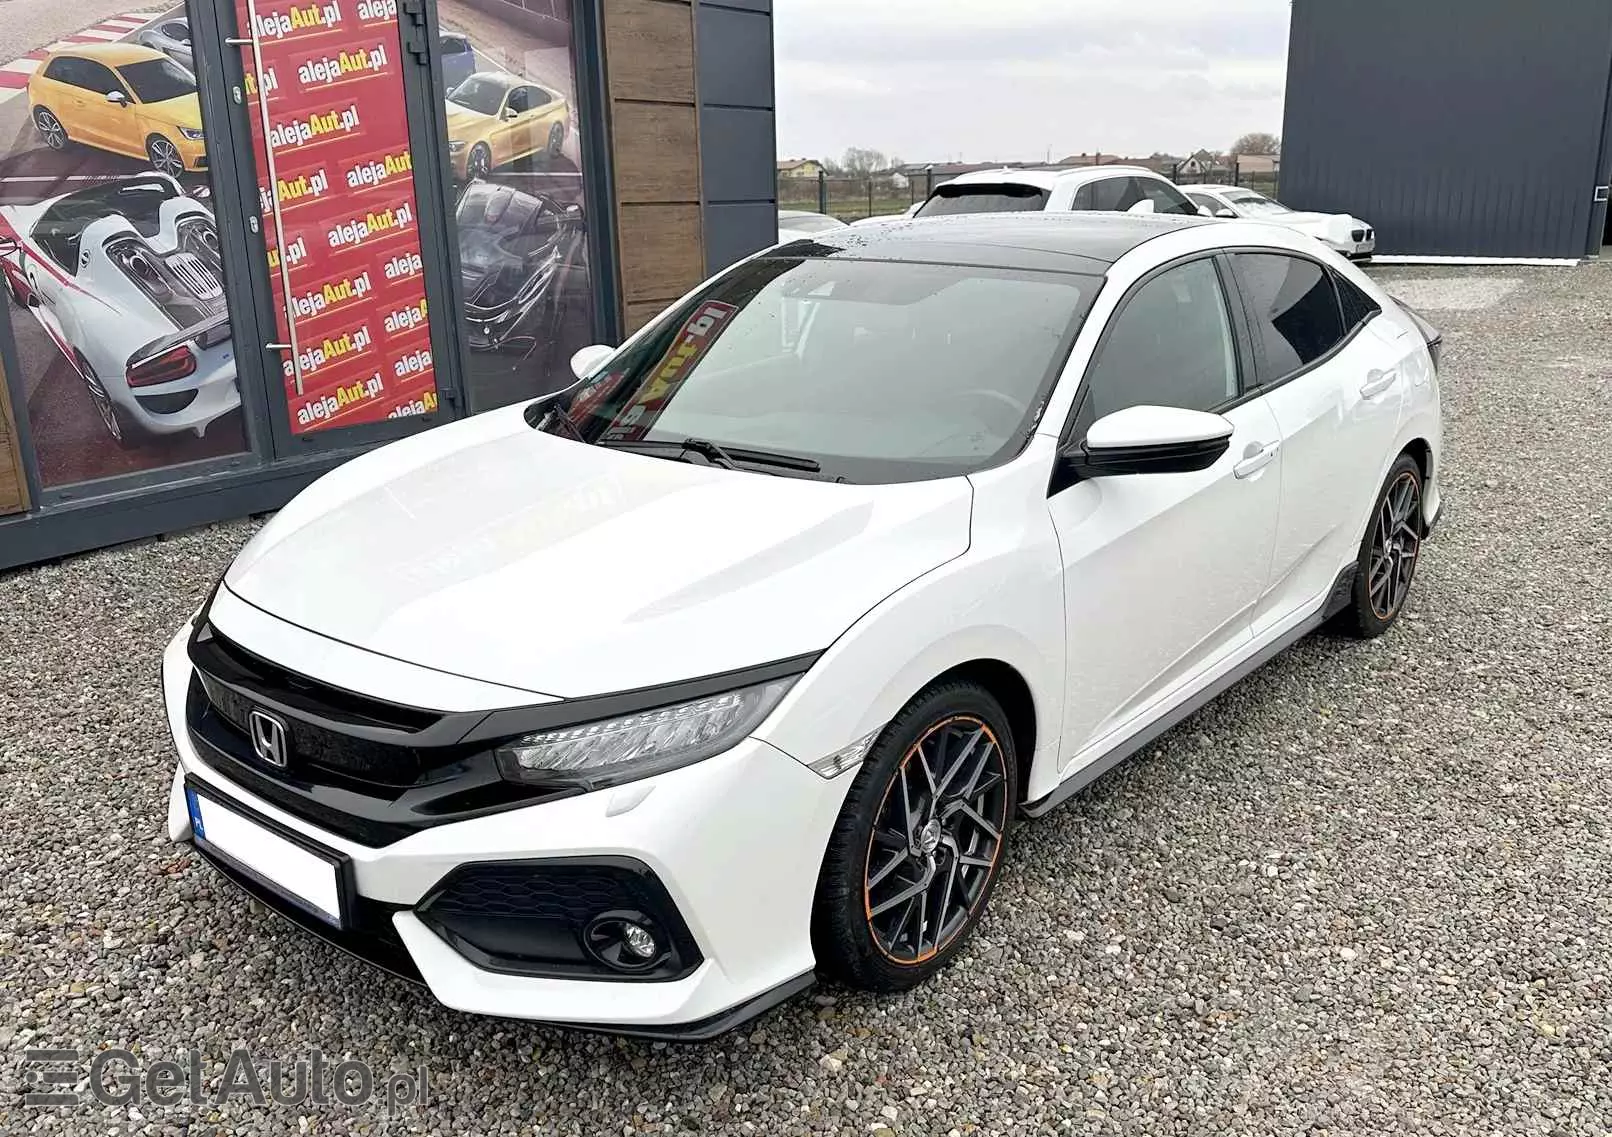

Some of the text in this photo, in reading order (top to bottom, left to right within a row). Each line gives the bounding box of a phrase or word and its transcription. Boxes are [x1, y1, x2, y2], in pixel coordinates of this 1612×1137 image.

[298, 45, 387, 84] alejaAut.pl
[271, 105, 359, 147] alejaAut.pl
[328, 203, 413, 247] alejaAut.pl
[283, 326, 371, 376] aejaAut.pl
[297, 373, 384, 425] alejaAut.pl
